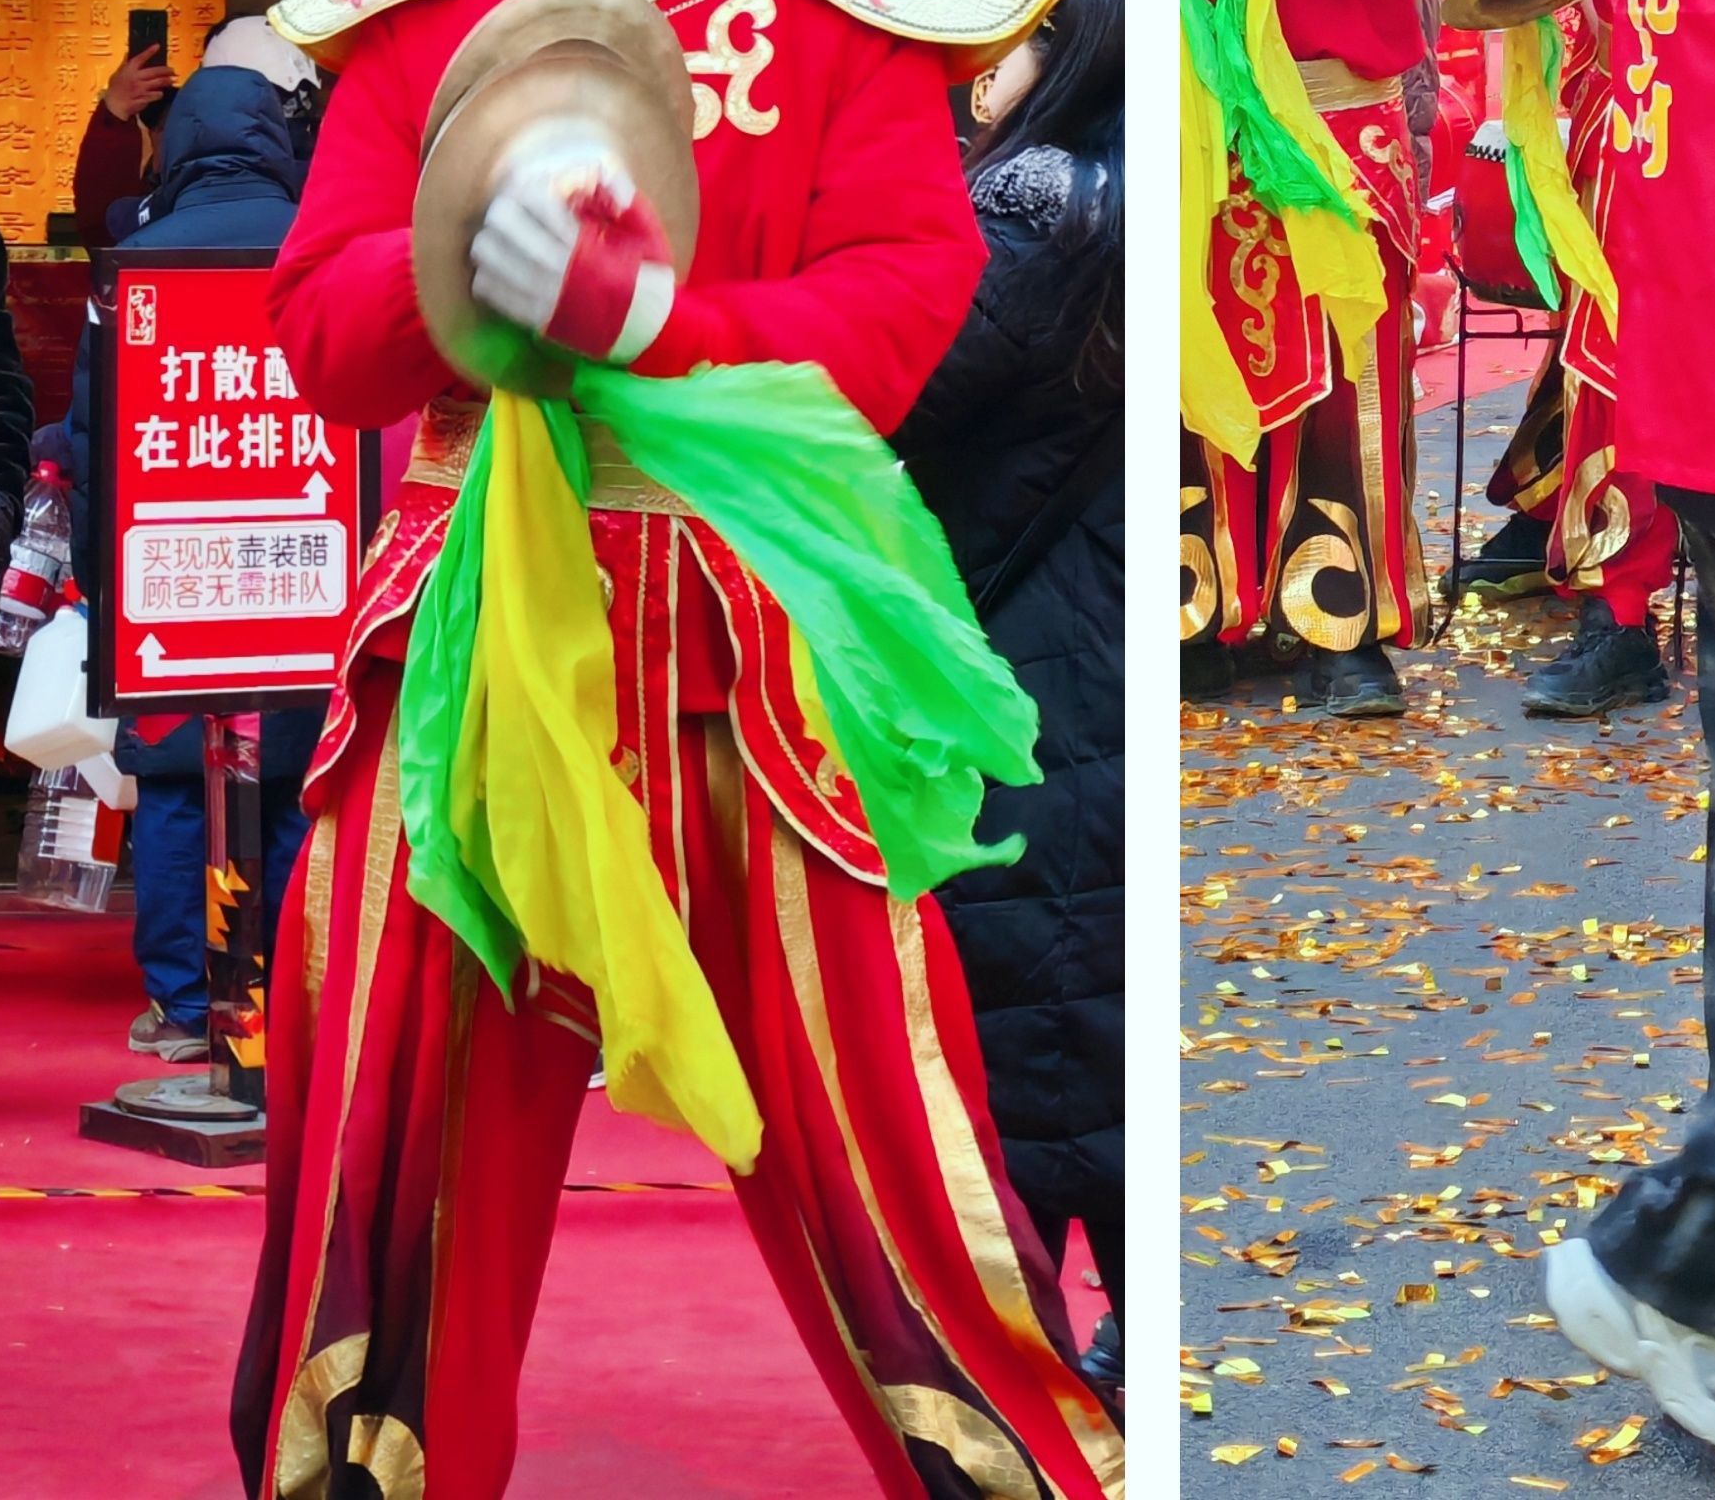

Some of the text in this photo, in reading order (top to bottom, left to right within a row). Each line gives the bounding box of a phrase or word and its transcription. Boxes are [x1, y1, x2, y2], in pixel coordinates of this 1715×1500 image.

[133, 413, 336, 471] 在此排队
[142, 534, 330, 570] 买现成壶装醋
[141, 571, 329, 611] 顾客无需排队
